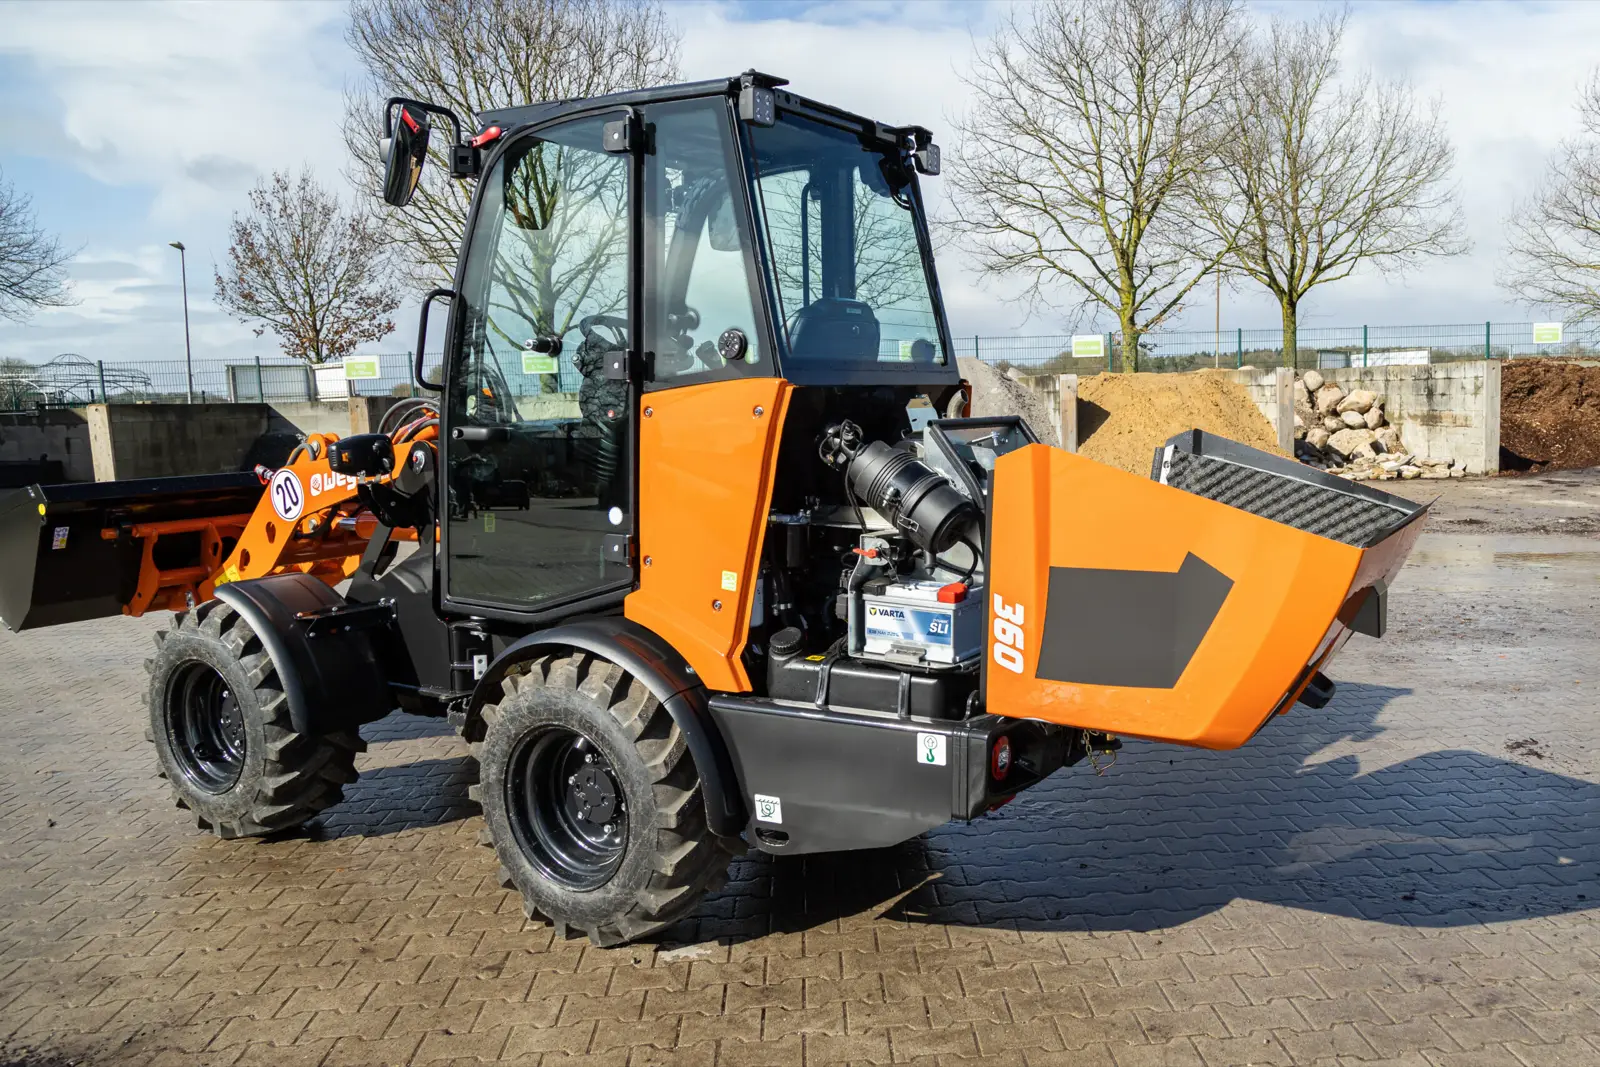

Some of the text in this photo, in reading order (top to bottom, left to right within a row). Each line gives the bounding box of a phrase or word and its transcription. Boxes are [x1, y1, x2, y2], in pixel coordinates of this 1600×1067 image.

[275, 476, 299, 515] 20
[878, 608, 905, 619] VARTA
[929, 622, 949, 634] SLI
[993, 593, 1024, 674] 360
